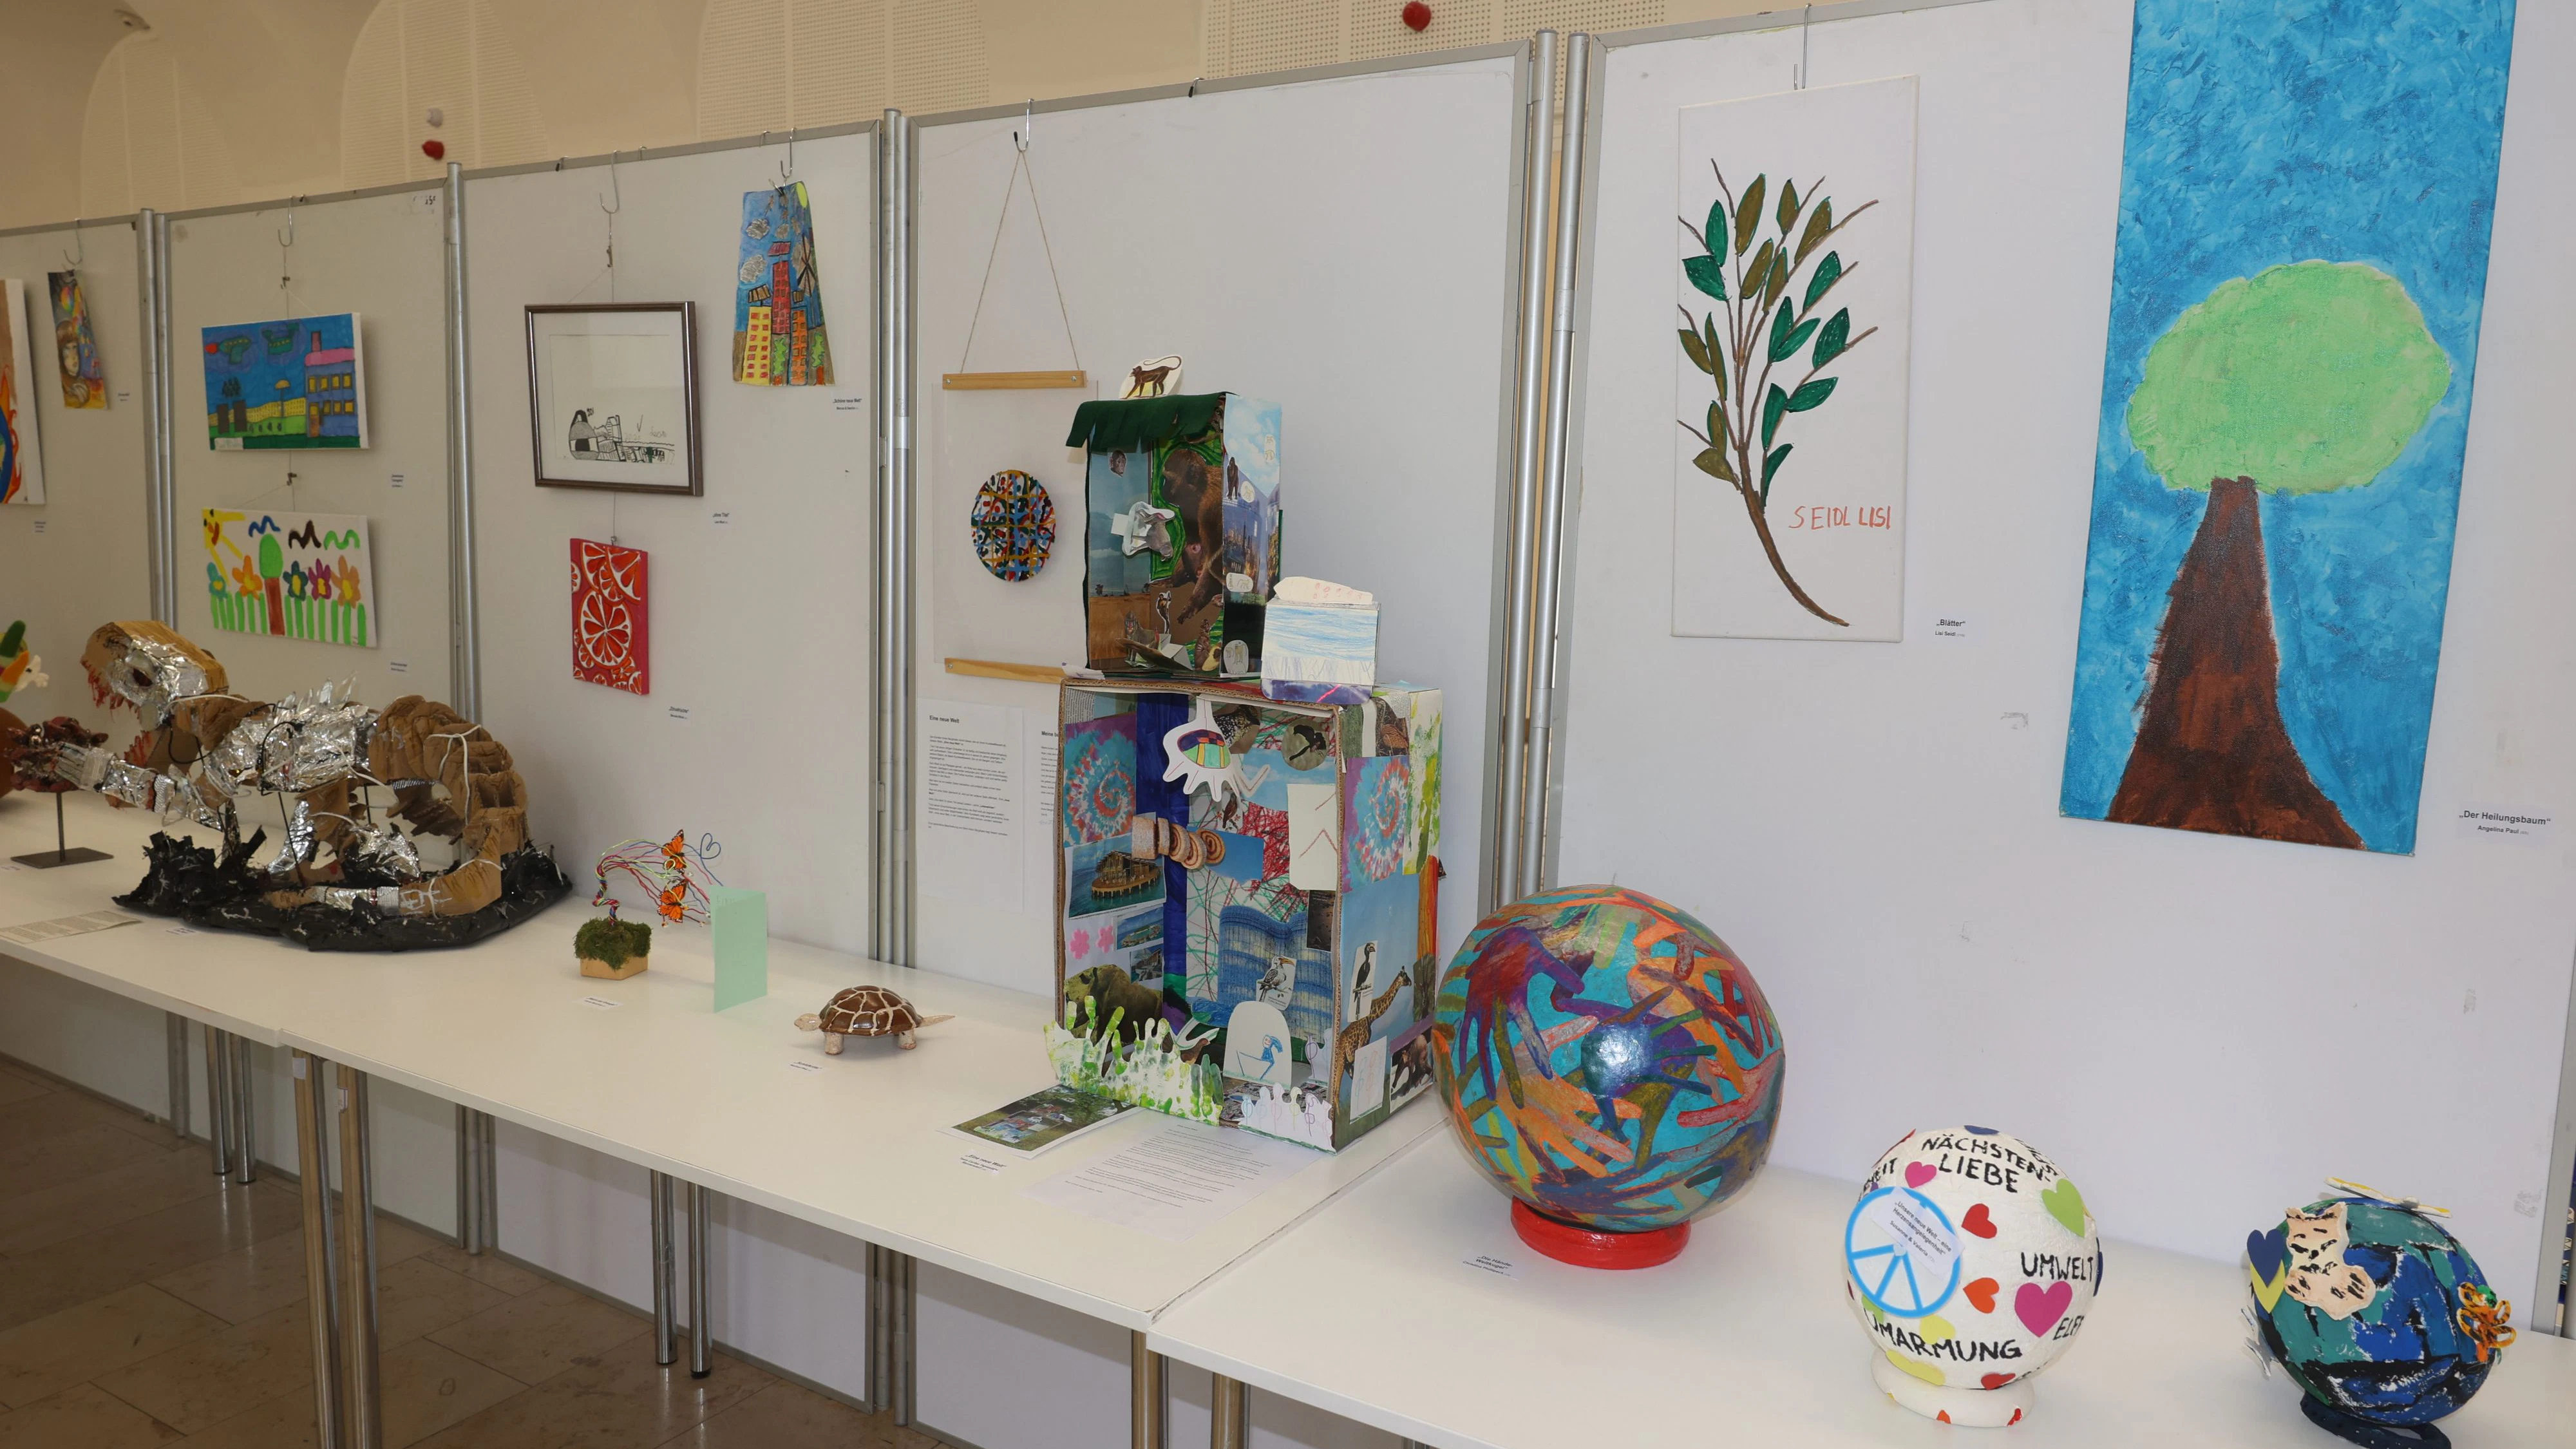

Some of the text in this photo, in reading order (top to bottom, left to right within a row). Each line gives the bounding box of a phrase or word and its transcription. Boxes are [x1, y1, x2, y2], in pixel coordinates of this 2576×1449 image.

[1788, 505, 1891, 530] SEIDL LISI
[1938, 1153, 2018, 1193] LIEBE
[1889, 1220, 1909, 1238] Susanne
[1913, 1240, 1929, 1256] Valeria
[1914, 1217, 1926, 1229] neue
[1926, 1226, 1938, 1239] Welt
[1941, 1241, 1952, 1252] eine
[2020, 1251, 2094, 1282] UMWELT
